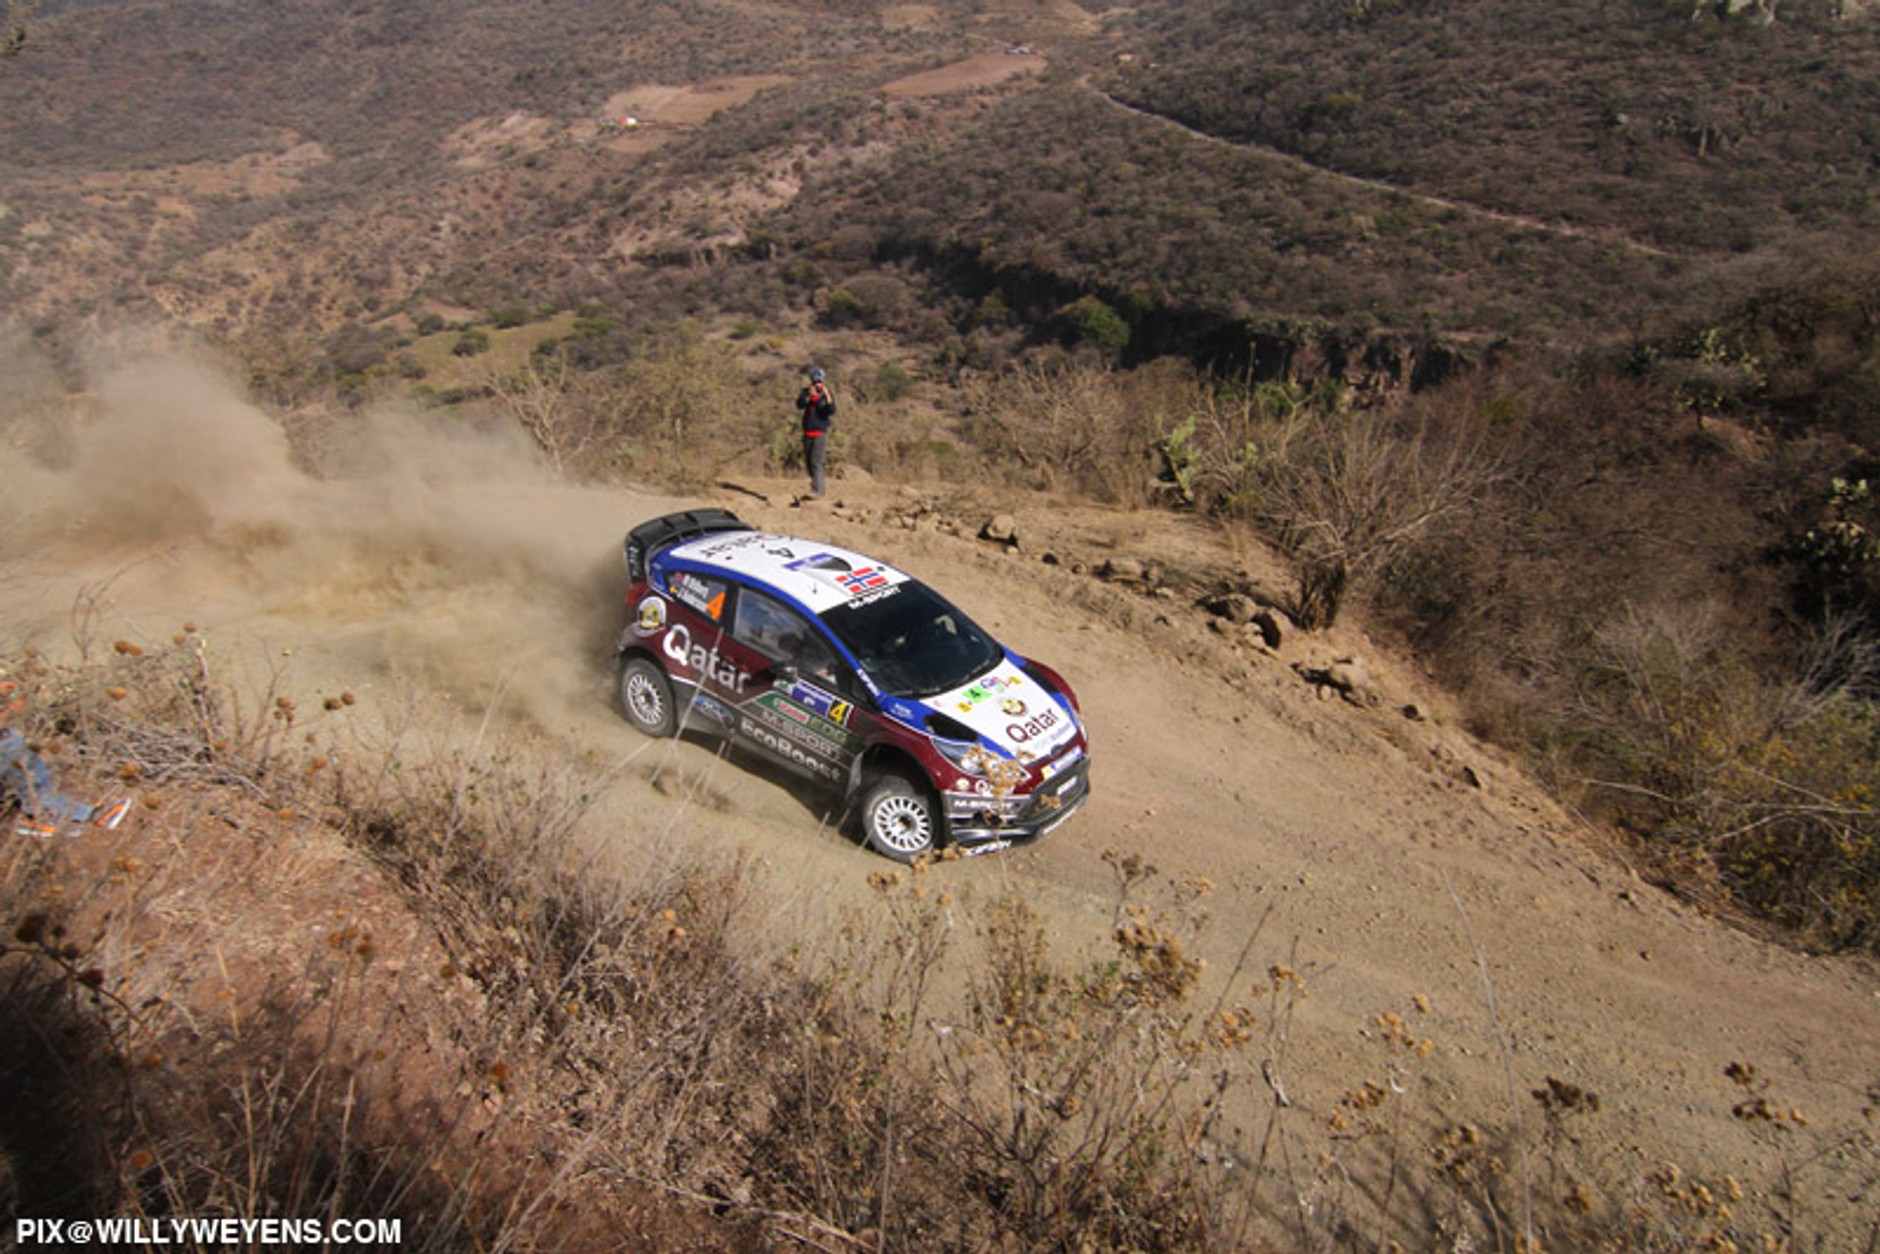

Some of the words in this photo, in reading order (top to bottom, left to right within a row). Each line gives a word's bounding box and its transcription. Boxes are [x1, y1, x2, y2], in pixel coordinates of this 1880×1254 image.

[706, 591, 727, 621] 4
[663, 623, 751, 695] Qatar
[829, 702, 847, 725] 4
[1005, 708, 1060, 743] Qatar
[740, 716, 841, 781] EcoBoost
